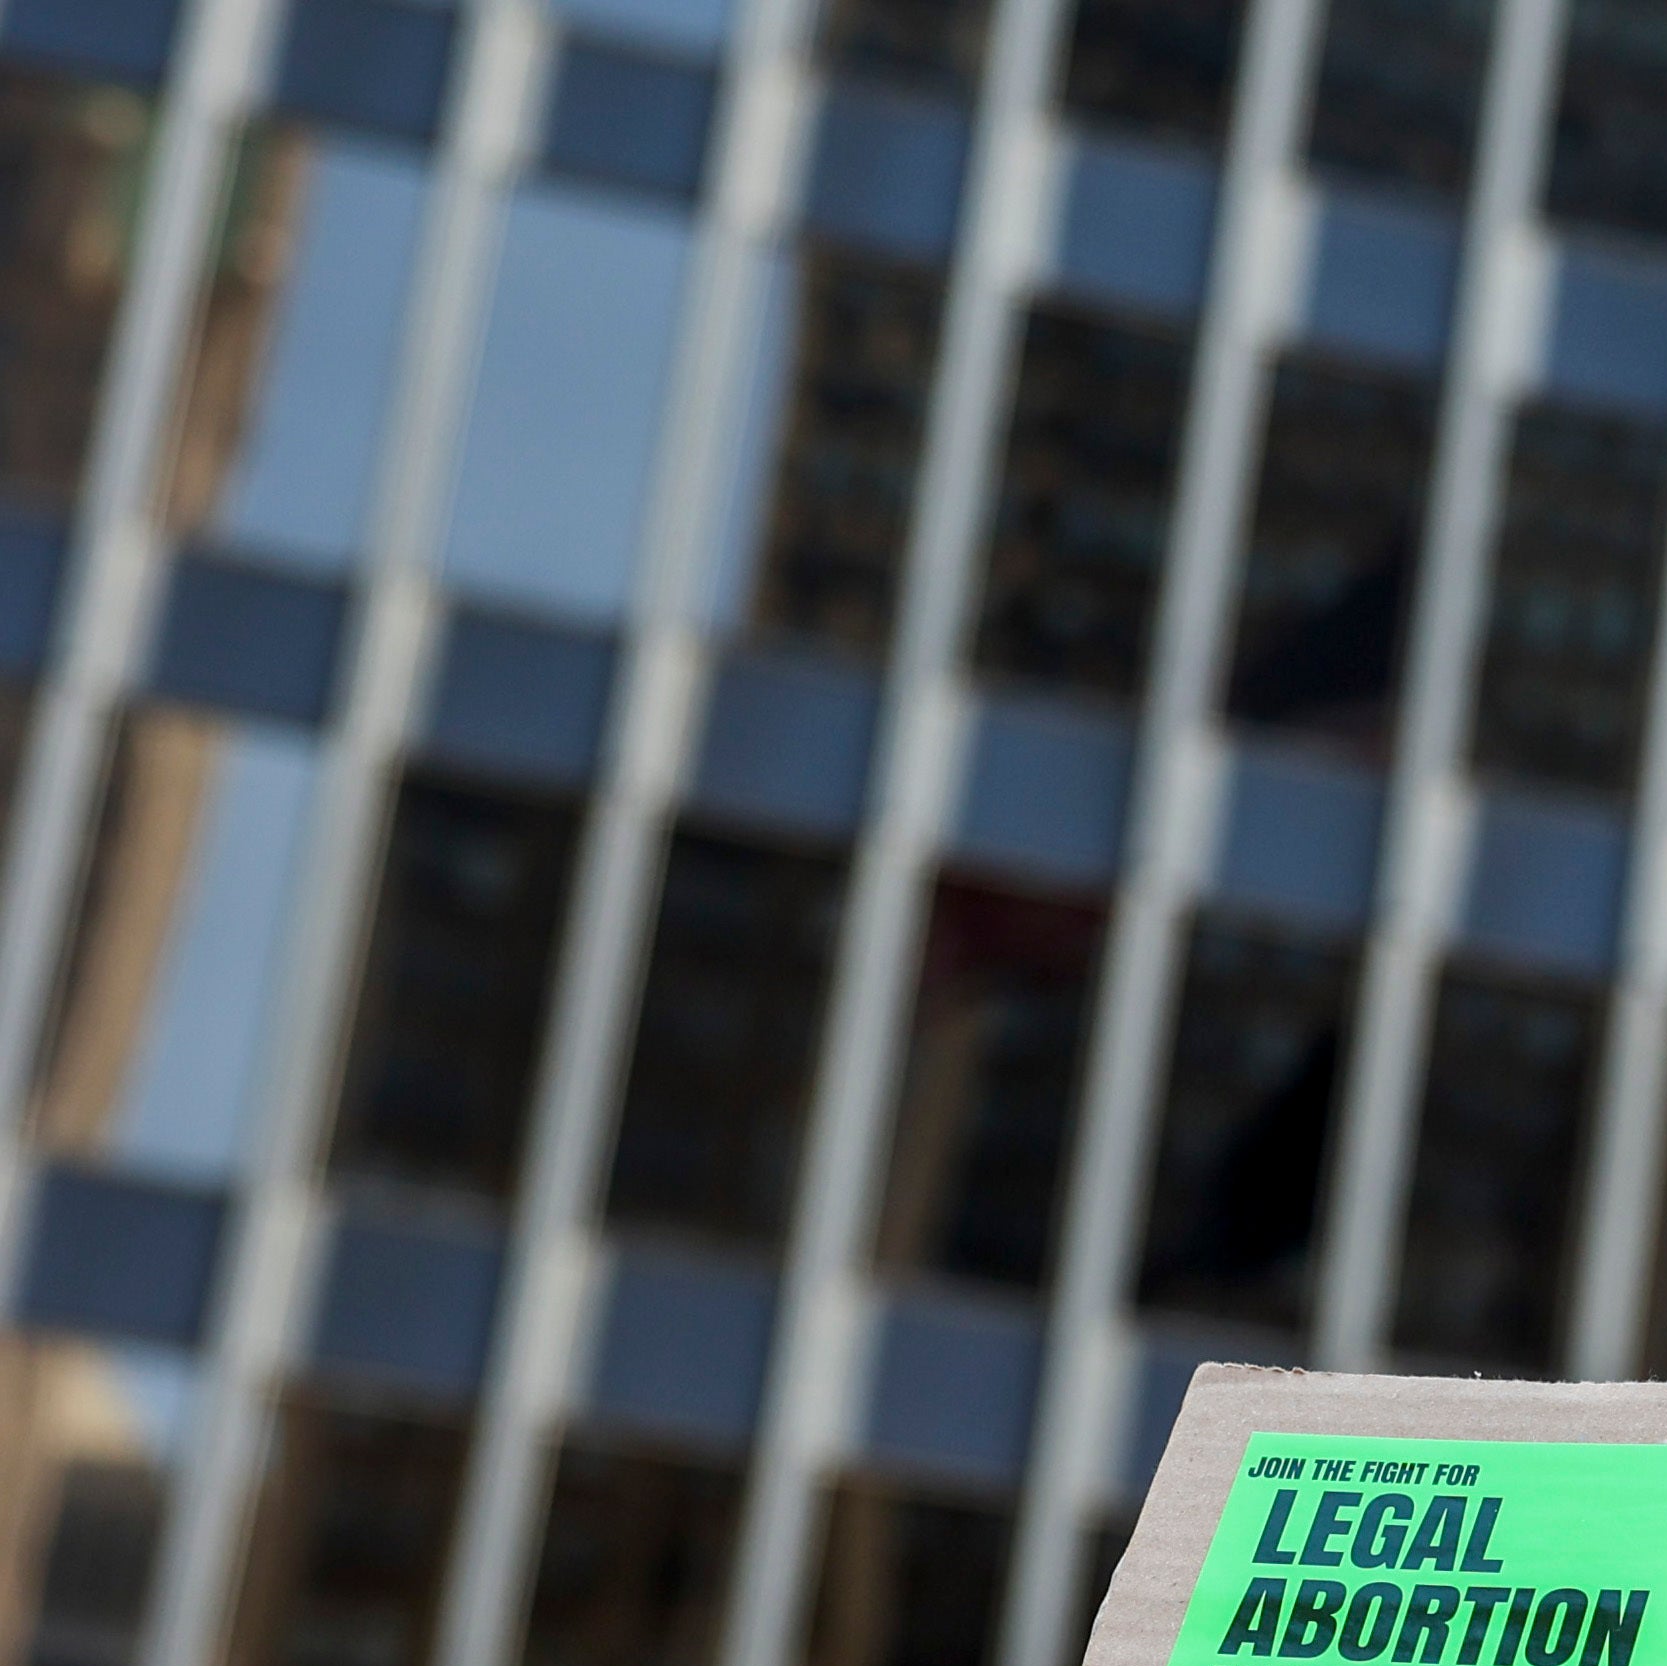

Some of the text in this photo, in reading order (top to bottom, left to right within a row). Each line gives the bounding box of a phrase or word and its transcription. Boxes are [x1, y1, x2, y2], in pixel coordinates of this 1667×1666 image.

[1247, 1456, 1481, 1487] JOIN THE FIGHT FOR
[1251, 1489, 1505, 1574] LEGAL
